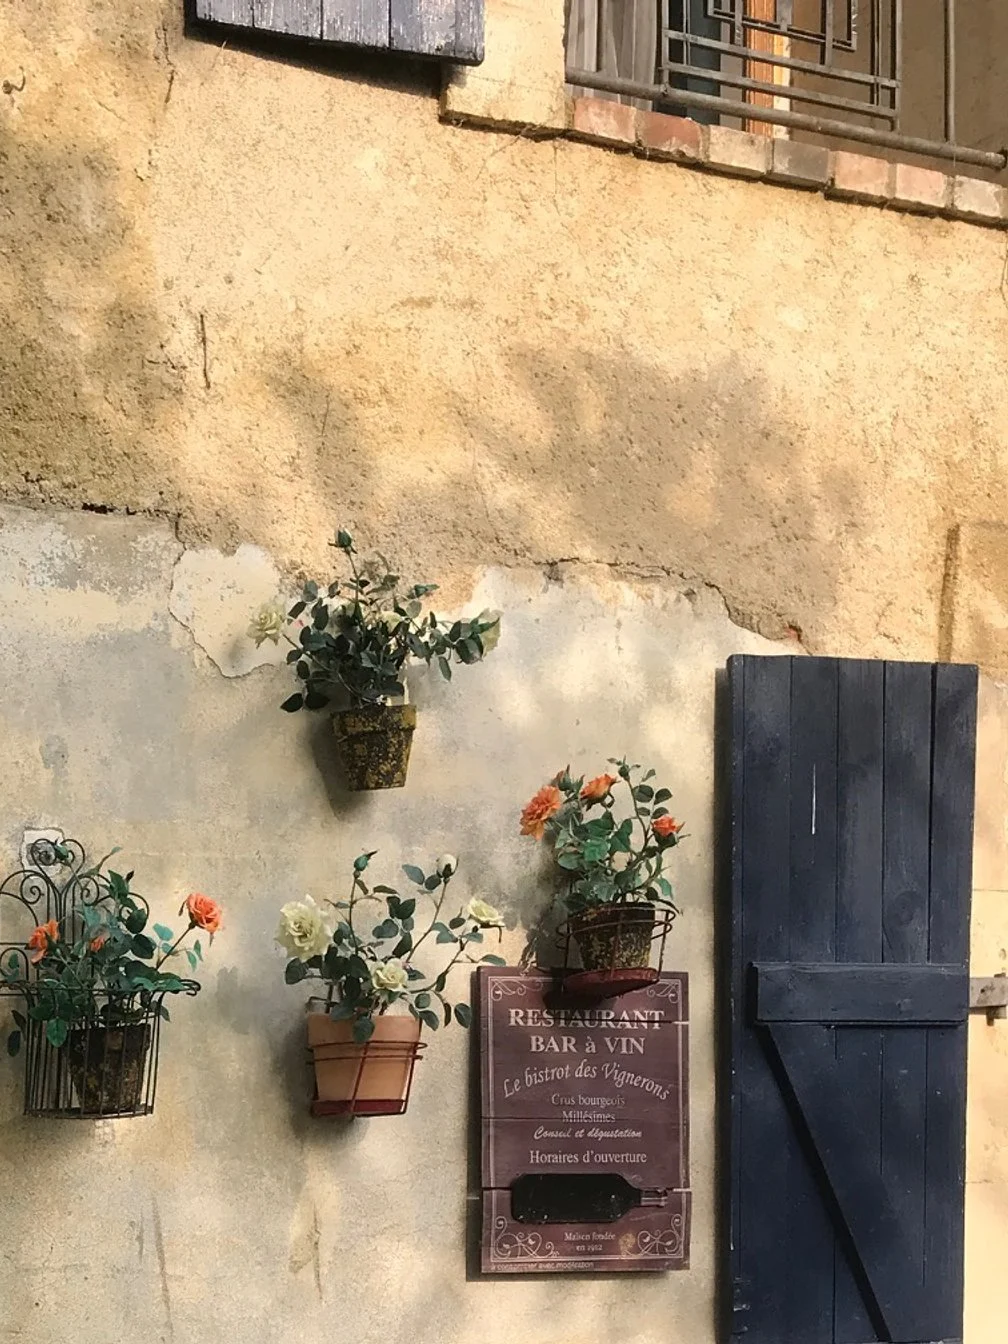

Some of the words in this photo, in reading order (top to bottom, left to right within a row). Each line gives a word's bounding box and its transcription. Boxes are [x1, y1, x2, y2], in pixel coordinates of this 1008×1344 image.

[508, 1008, 665, 1030] RESTAURANT
[530, 1035, 578, 1053] BAR
[585, 1036, 597, 1054] à
[604, 1037, 645, 1055] VIN
[503, 1078, 522, 1098] Le
[525, 1064, 571, 1088] bistrot
[575, 1058, 597, 1079] des
[601, 1062, 671, 1100] Vignerons
[551, 1093, 576, 1106] Crus
[578, 1094, 626, 1109] bourgeois
[562, 1110, 616, 1123] Millésimes
[533, 1125, 572, 1140] Conseil
[574, 1128, 584, 1138] et
[587, 1127, 643, 1141] dégustation
[529, 1150, 579, 1164] Horaires
[582, 1150, 648, 1164] d'ouverture
